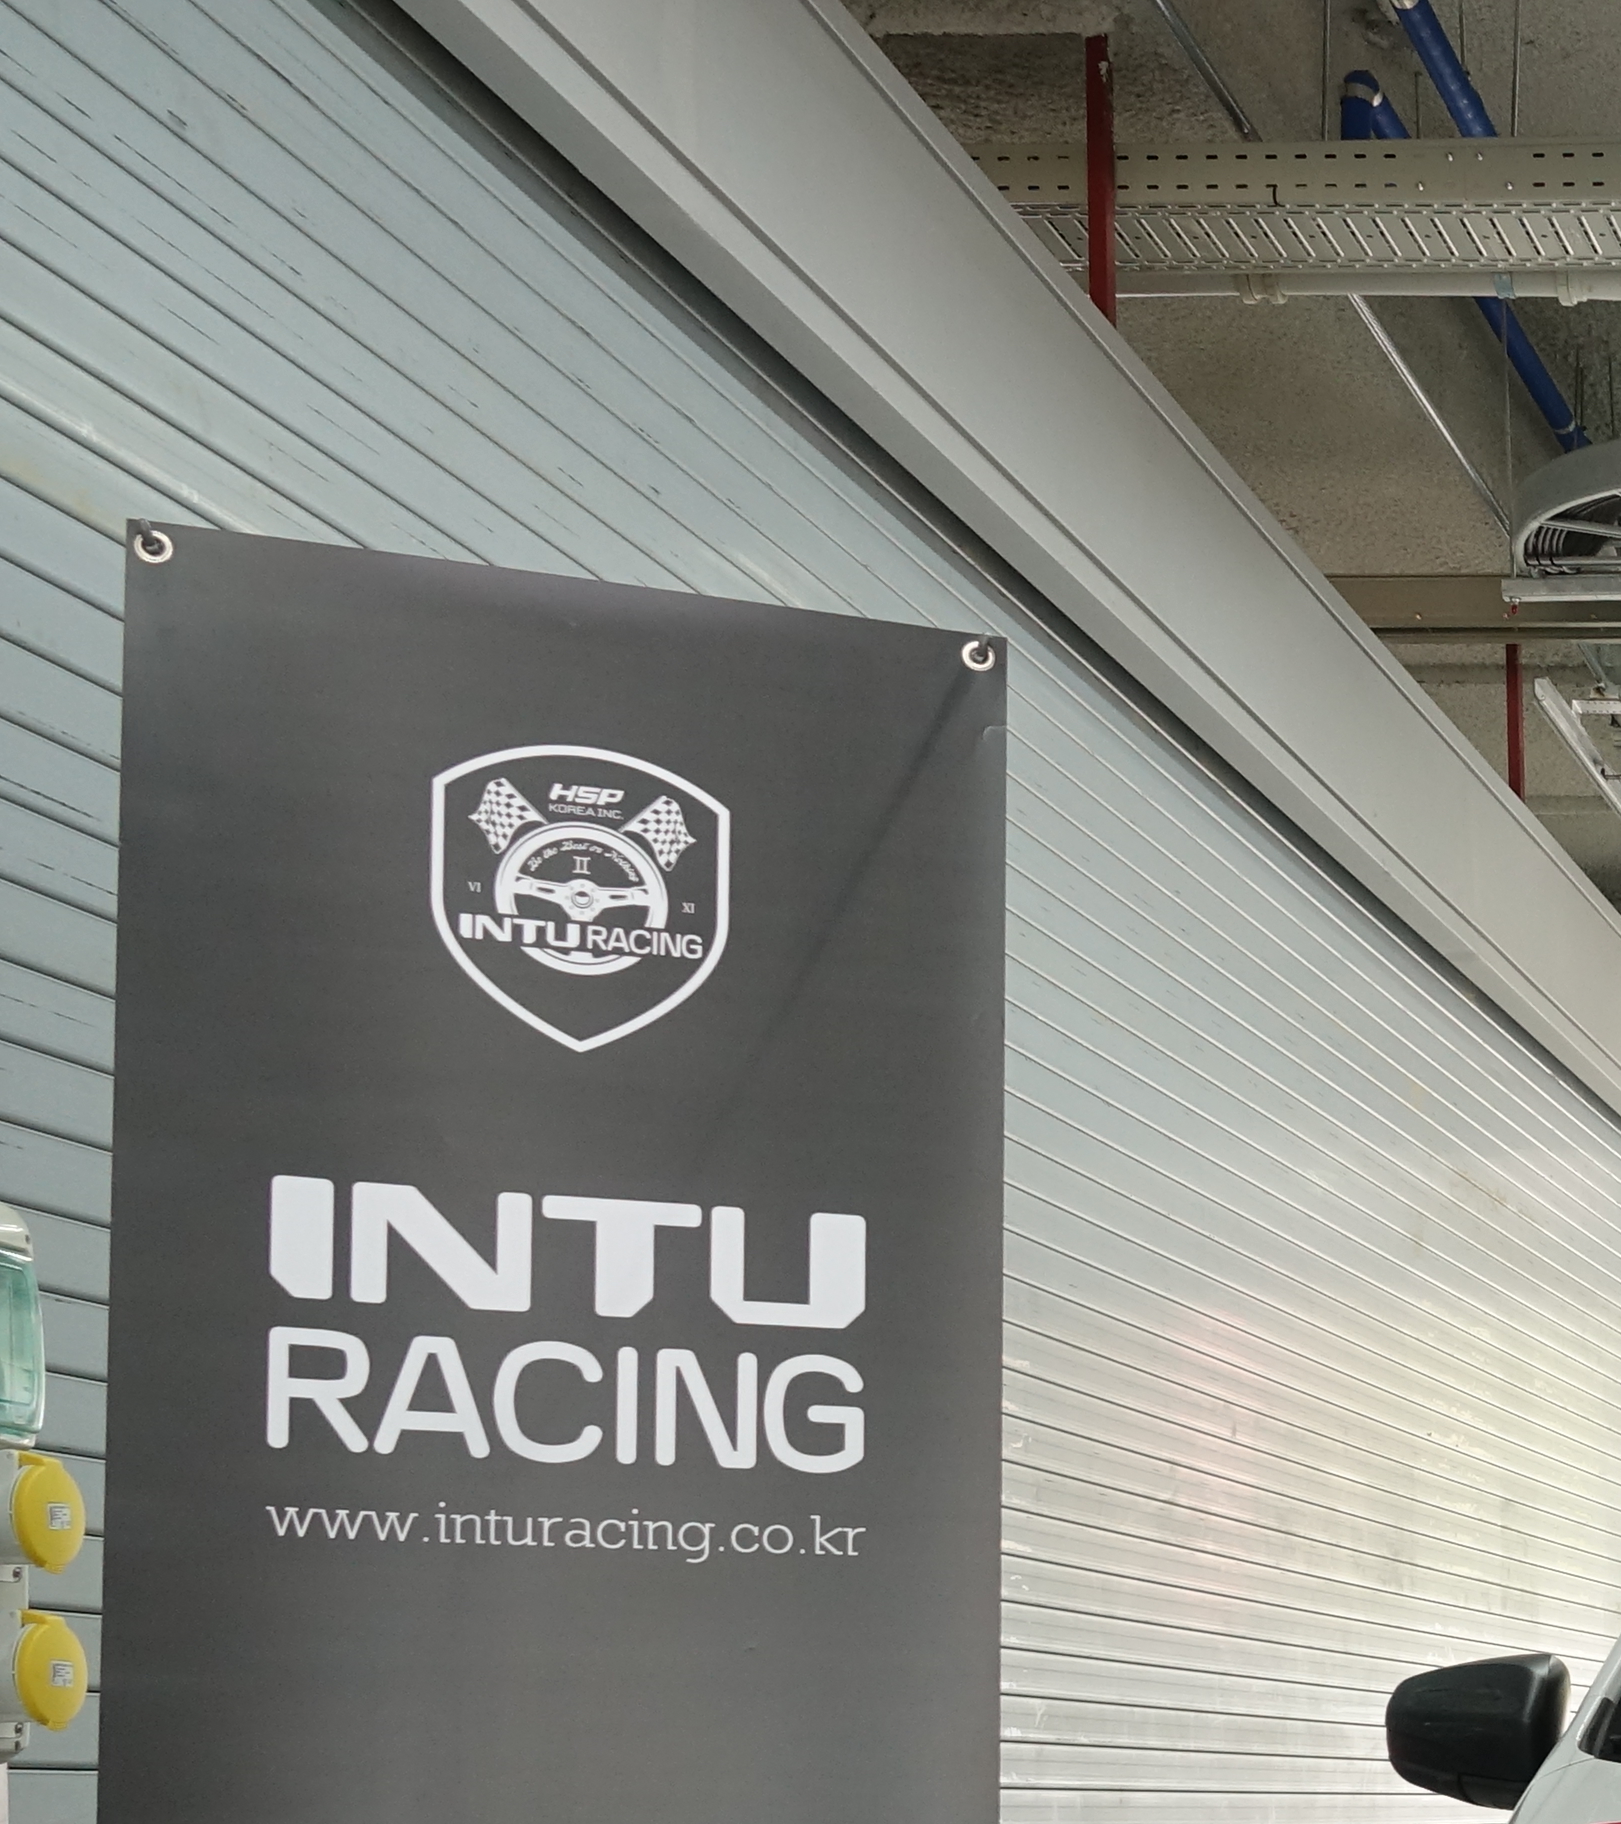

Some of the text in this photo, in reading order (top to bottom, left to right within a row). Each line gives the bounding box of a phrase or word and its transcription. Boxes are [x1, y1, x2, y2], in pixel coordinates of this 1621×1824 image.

[548, 783, 625, 806] HSP
[548, 803, 596, 817] KOREA
[459, 913, 703, 959] INTU RACING
[269, 1174, 867, 1329] INTU
[266, 1325, 866, 1475] RACING
[266, 1503, 867, 1566] www.inturacing.co.kr
